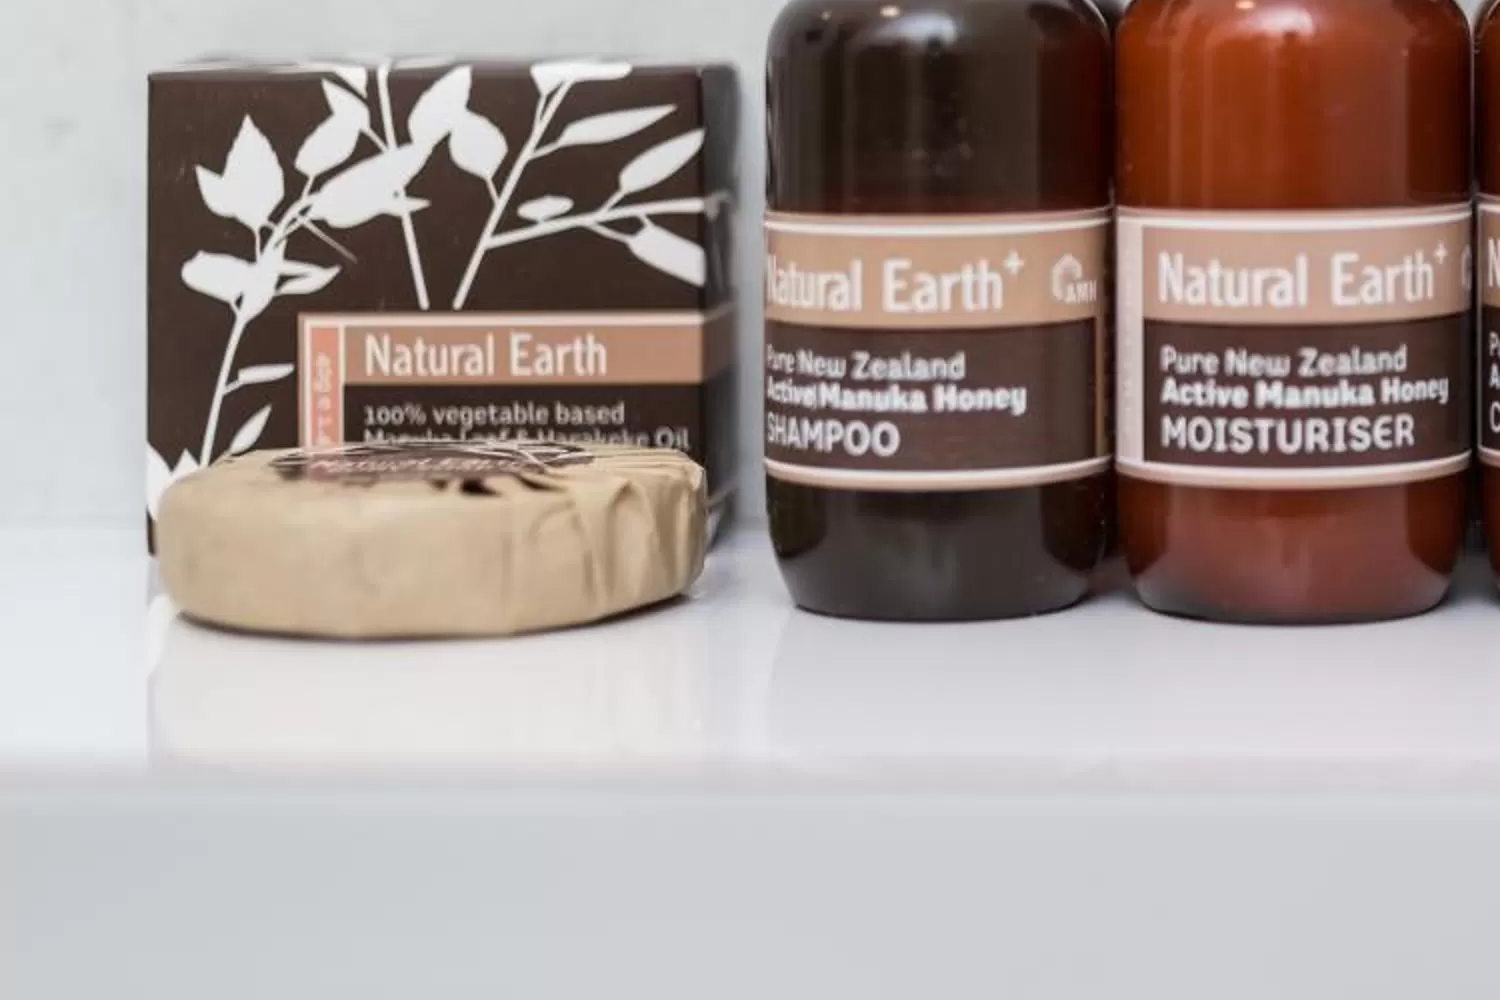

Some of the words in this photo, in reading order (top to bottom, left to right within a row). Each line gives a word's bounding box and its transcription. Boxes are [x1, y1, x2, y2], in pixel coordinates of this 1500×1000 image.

[767, 251, 863, 311] Natural
[1157, 250, 1309, 308] Natural
[364, 330, 495, 378] Natural
[509, 330, 608, 378] Earth
[798, 349, 846, 379] New
[851, 349, 966, 382] Zealand
[1159, 344, 1221, 374] Pure
[1224, 347, 1291, 377] New
[1298, 343, 1408, 378] Zealand
[767, 375, 816, 410] Active
[820, 382, 928, 414] Manuka
[934, 385, 1027, 416] Honey
[1160, 377, 1249, 408] Active
[1254, 378, 1376, 411] Manuka
[1381, 374, 1449, 406] Honey
[364, 402, 427, 426] 100%
[432, 401, 550, 431] vegetable
[554, 401, 626, 426] based
[767, 413, 901, 458] SHAMPOO
[1160, 413, 1415, 454] MOISTURISER
[654, 426, 690, 450] Oil
